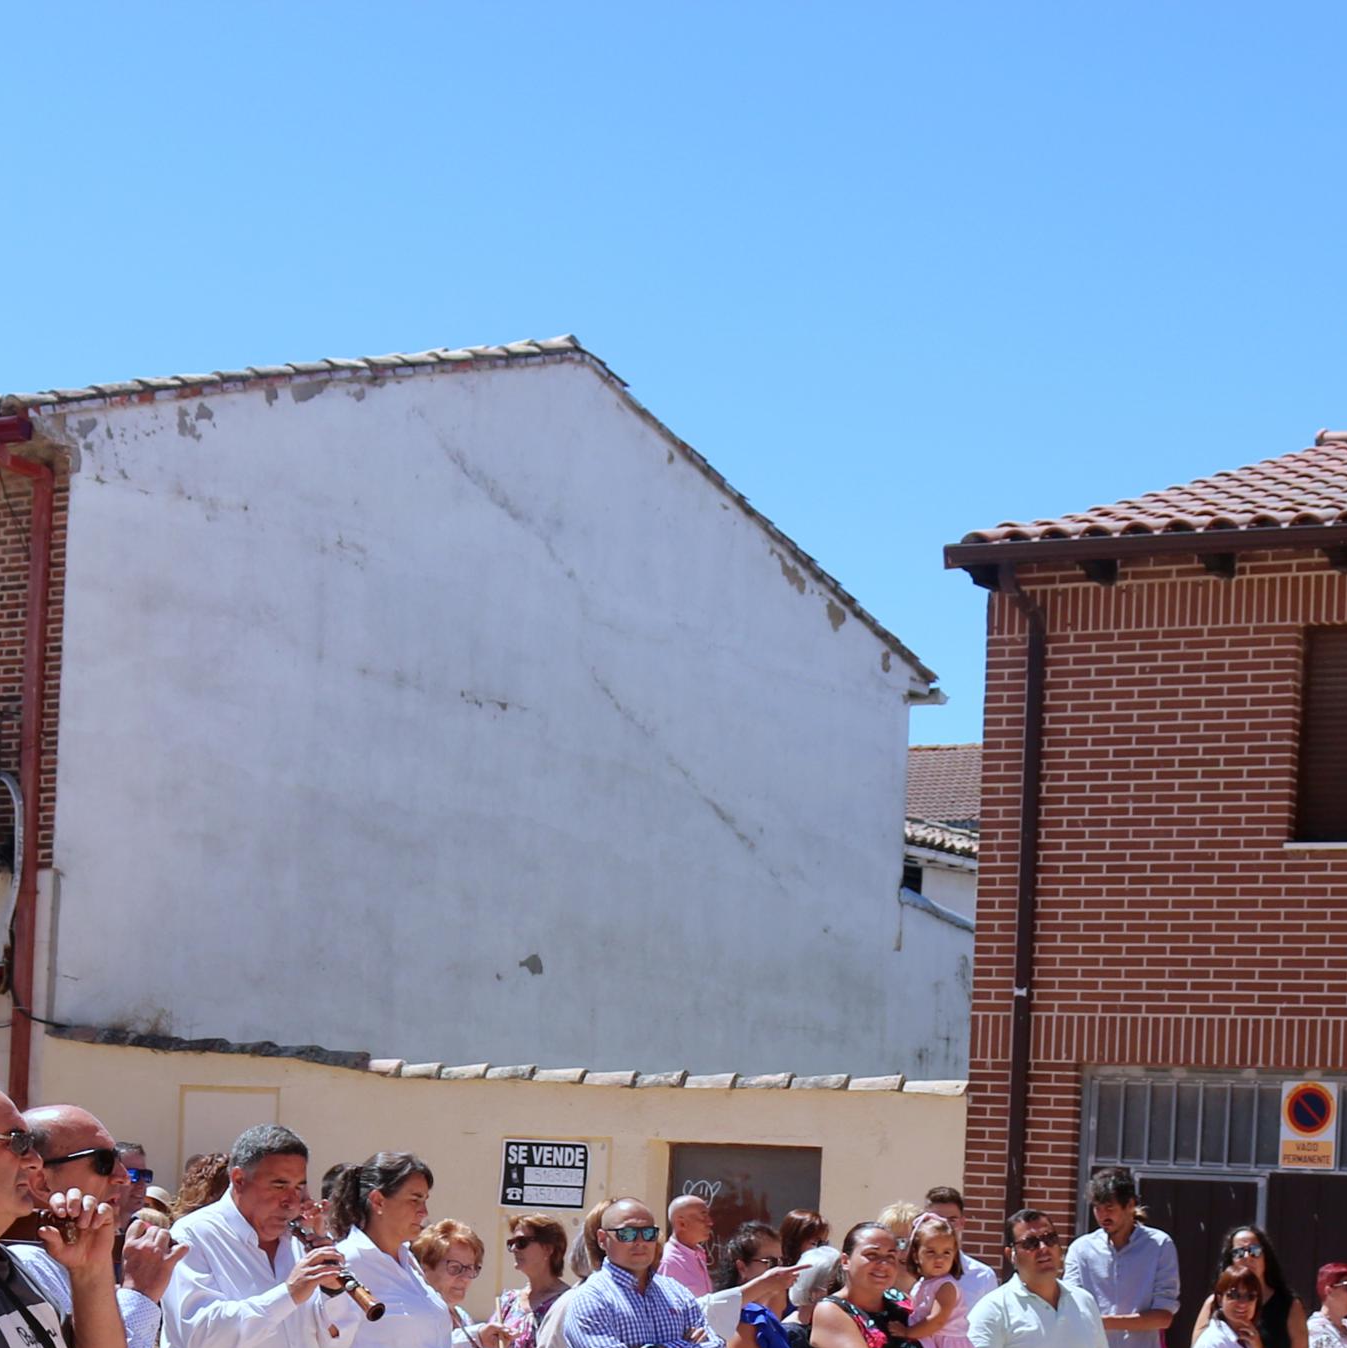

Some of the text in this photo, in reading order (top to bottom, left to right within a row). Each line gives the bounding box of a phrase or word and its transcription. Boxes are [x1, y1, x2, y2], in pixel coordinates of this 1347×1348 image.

[1295, 1142, 1319, 1152] VADO
[507, 1145, 585, 1167] SE VENDE
[1283, 1154, 1331, 1165] PERMANENTE
